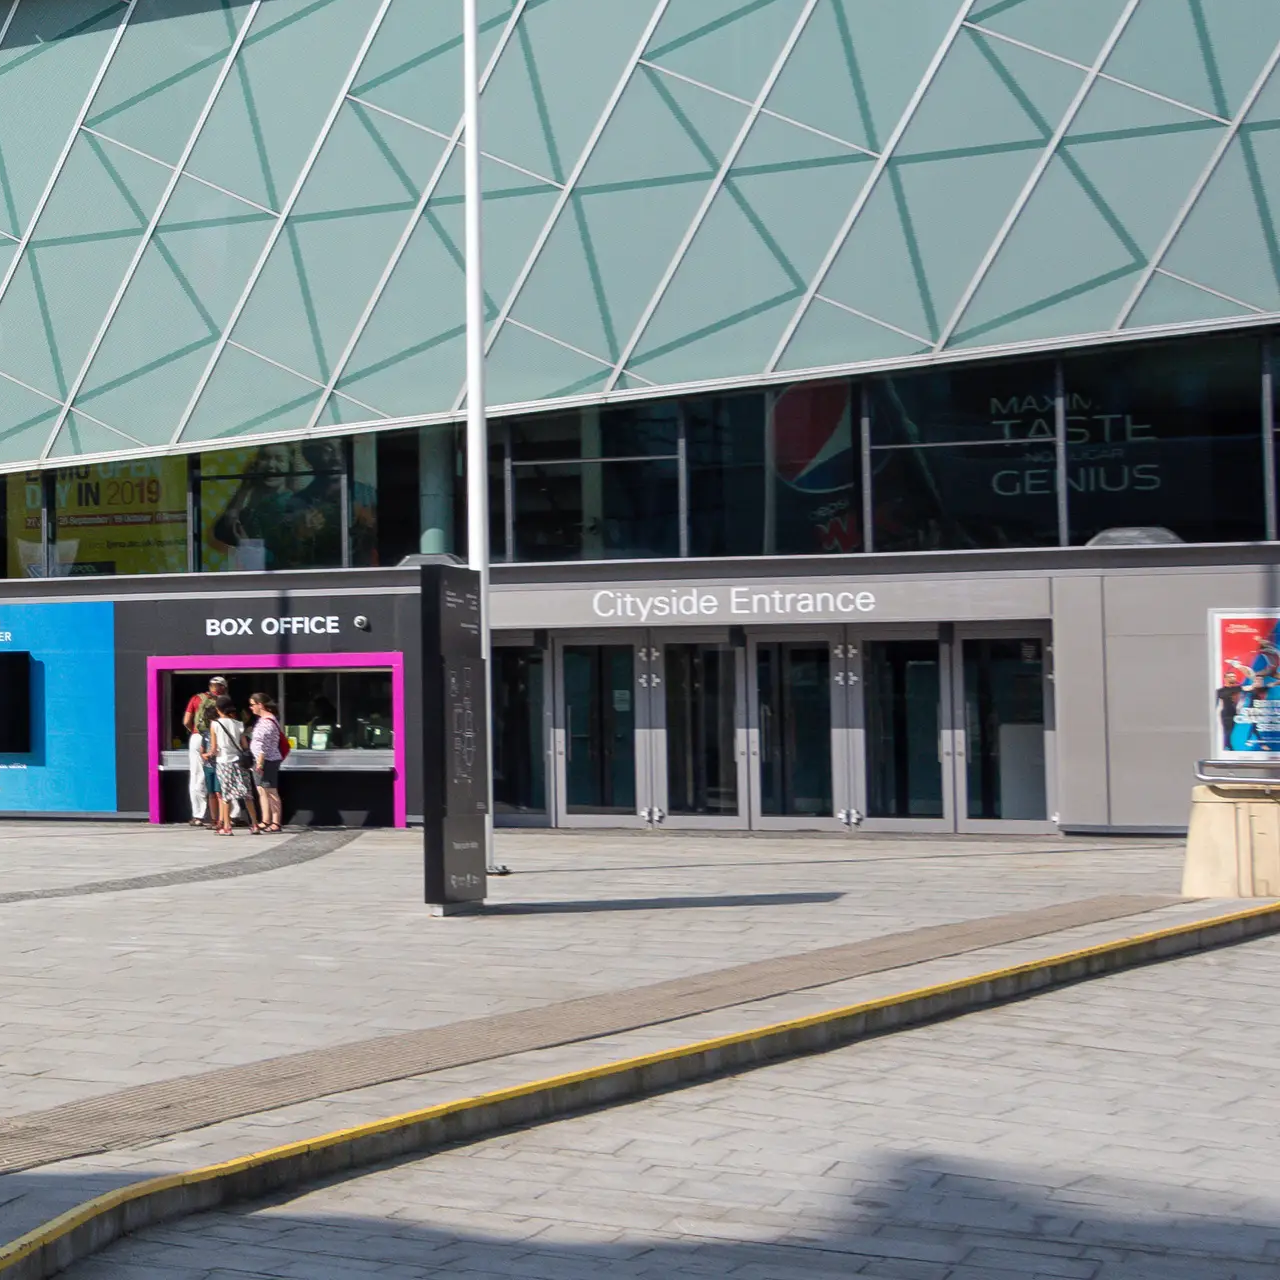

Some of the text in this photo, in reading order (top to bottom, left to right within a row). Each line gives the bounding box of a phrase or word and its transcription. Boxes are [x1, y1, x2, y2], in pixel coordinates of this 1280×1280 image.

[992, 414, 1160, 447] TASTE
[25, 478, 162, 510] DY IN 2019
[992, 464, 1162, 496] GENIUS
[592, 586, 877, 622] Cityside Entrance
[205, 615, 340, 636] BOX OFFICE
